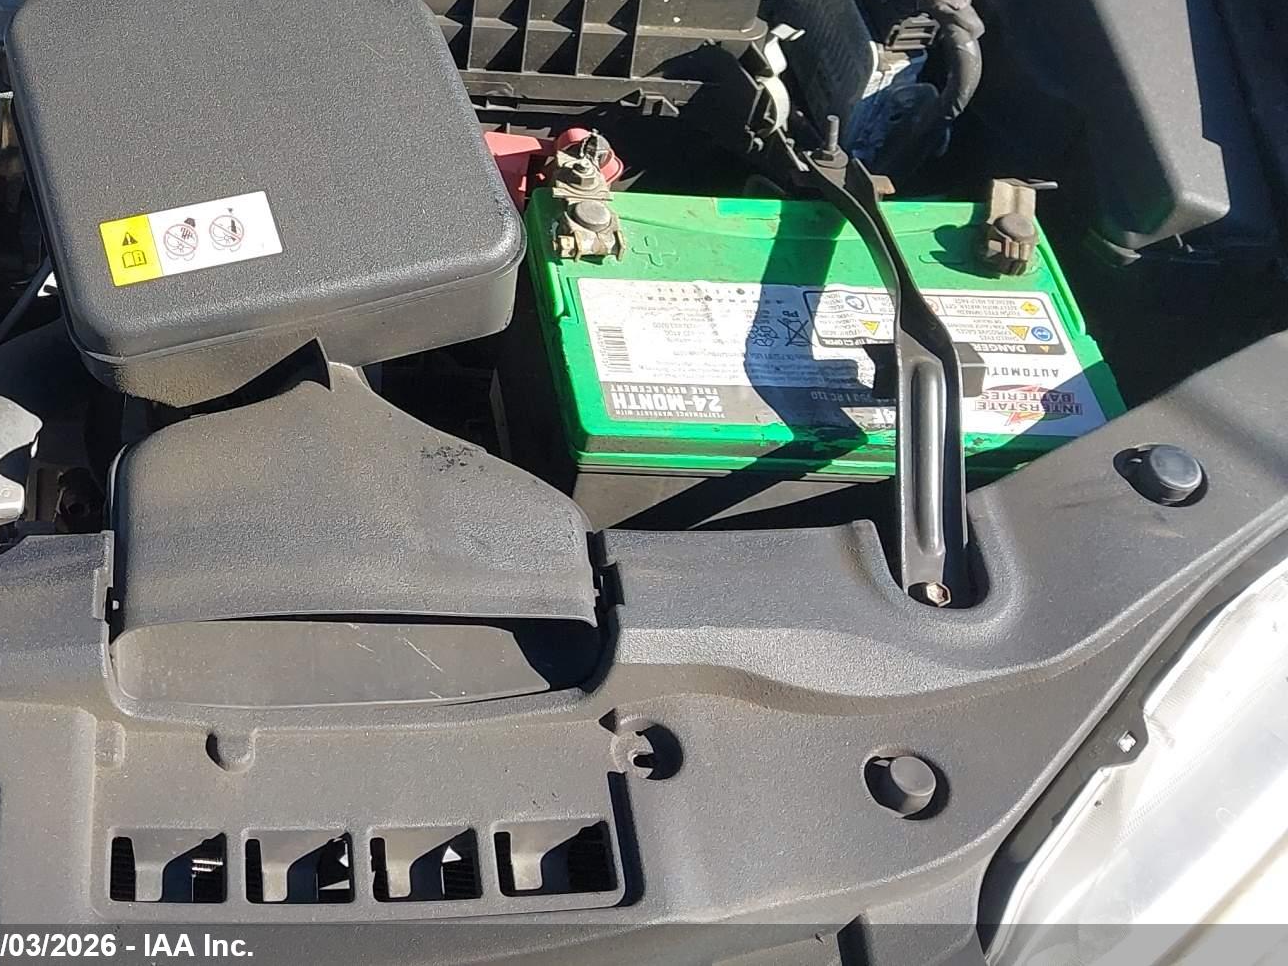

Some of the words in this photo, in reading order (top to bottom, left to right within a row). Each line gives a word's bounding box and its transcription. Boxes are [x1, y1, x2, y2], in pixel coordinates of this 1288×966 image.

[971, 343, 1027, 353] DANGER
[985, 366, 1059, 378] AUTOMOTI
[610, 384, 688, 394] REPLACEMENT
[690, 386, 718, 395] FREE
[611, 393, 722, 412] 24-MONTH
[979, 391, 1073, 403] BATTERIES
[976, 401, 1081, 415] INTERSTATE
